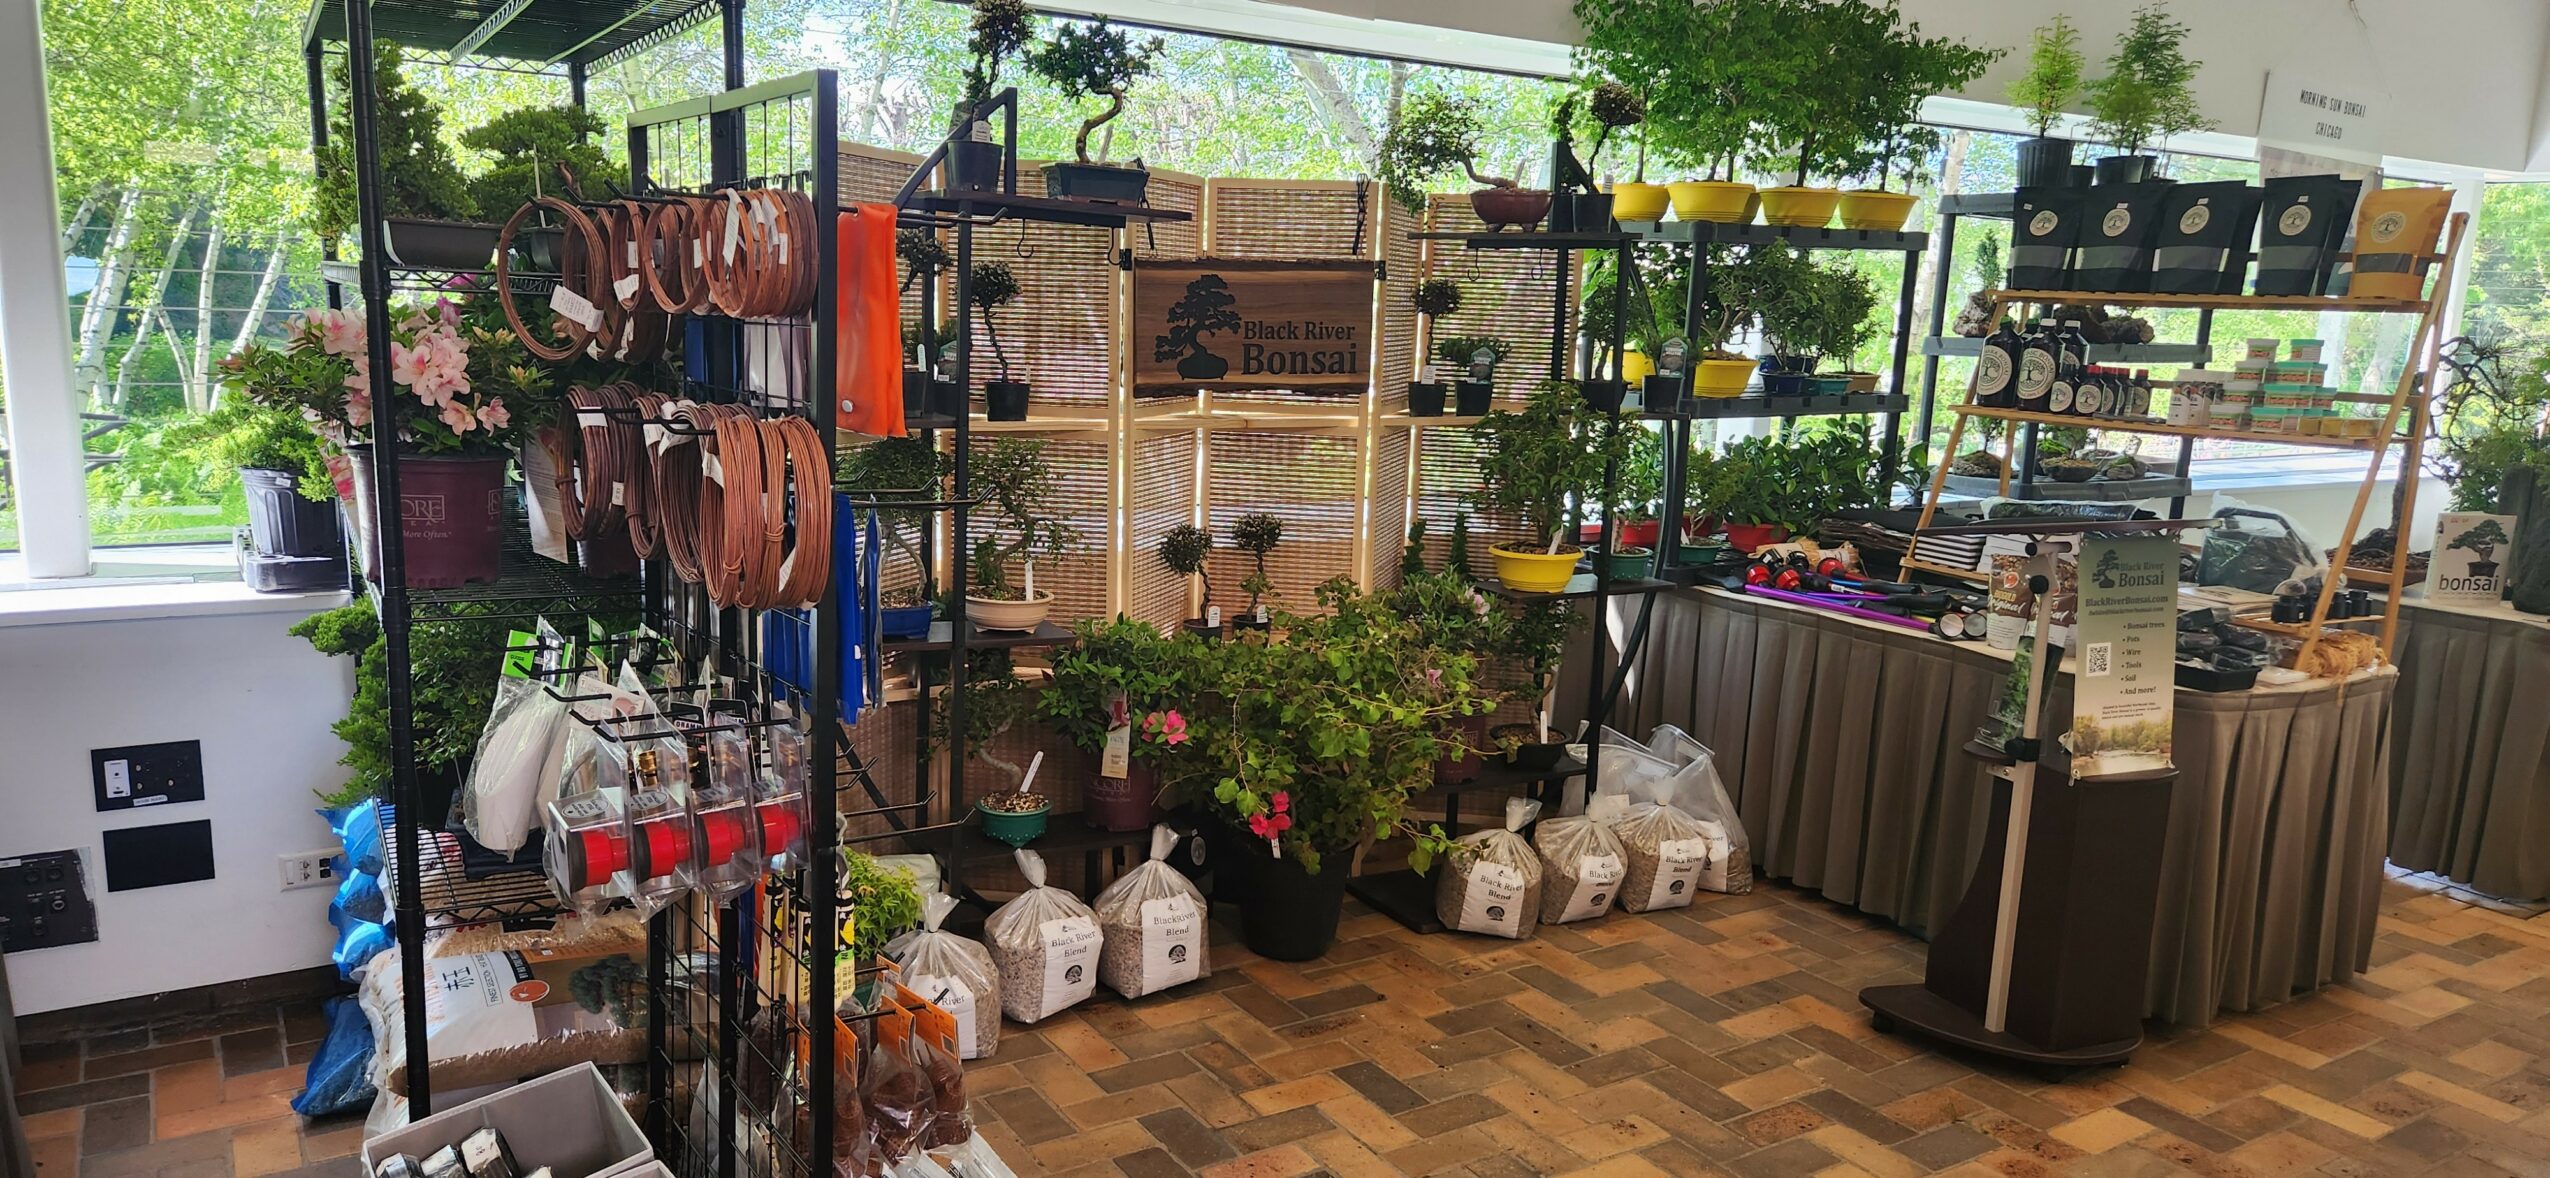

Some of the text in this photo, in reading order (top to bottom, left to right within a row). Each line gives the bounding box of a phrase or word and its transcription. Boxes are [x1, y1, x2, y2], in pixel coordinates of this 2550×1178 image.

[2300, 89, 2366, 118] MORNING SUN BONSAI
[2315, 122, 2342, 140] CHICAGO
[1243, 321, 1355, 340] Black River
[1241, 343, 1357, 375] Bonsai
[2119, 561, 2165, 572] Black River
[2118, 571, 2165, 588] Bonsai
[2439, 574, 2500, 592] bonsai
[2085, 596, 2169, 608] BlackRiverBonsai.com
[2127, 621, 2148, 630] Bonsai
[2126, 649, 2142, 657] Wire
[2125, 661, 2142, 669] Tools
[2124, 674, 2137, 682] Soil
[2124, 685, 2157, 695] And more!
[1480, 875, 1523, 893] Black River
[1488, 889, 1512, 901] Blend
[1166, 927, 1190, 937] Blend
[1051, 930, 1097, 948] Black River
[1063, 945, 1088, 959] Blend
[941, 995, 966, 1006] River
